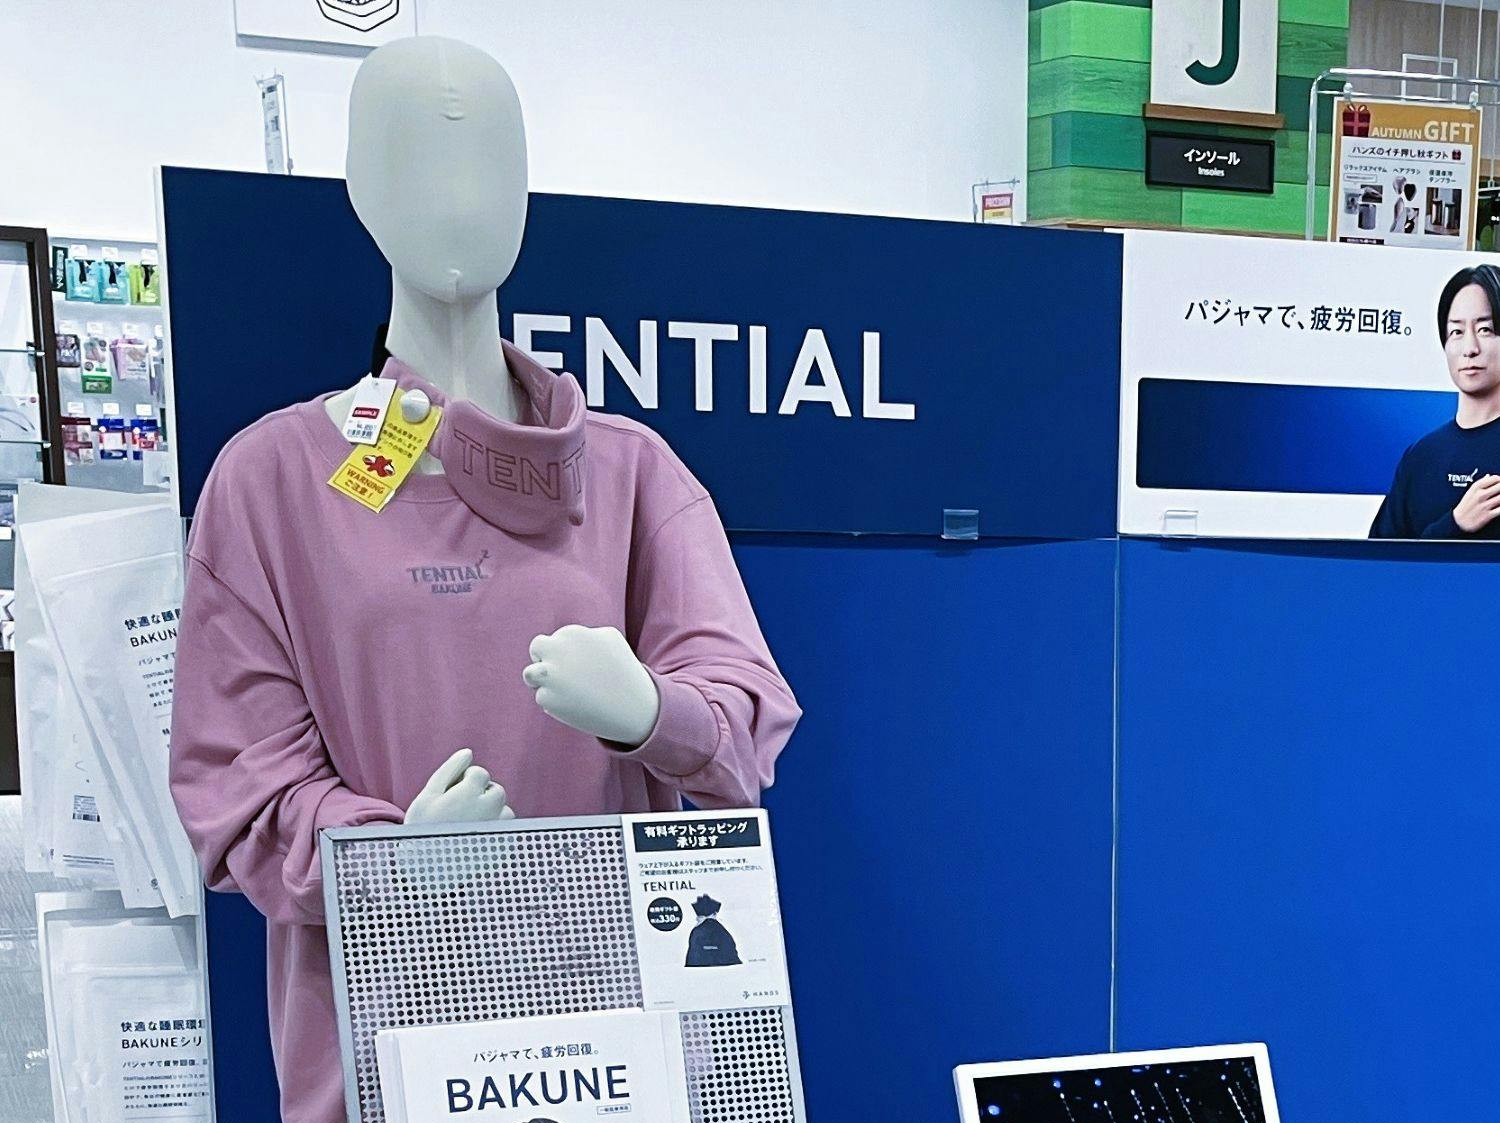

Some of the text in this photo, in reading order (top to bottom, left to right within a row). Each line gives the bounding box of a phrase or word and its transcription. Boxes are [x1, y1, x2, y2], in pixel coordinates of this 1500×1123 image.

[1185, 0, 1240, 86] J
[1371, 120, 1475, 143] AUTUMN GIFT
[1184, 148, 1240, 165] インソール
[1185, 299, 1412, 336] パジャマで、疲労回復。
[513, 313, 915, 420] ENTIAL
[346, 468, 385, 494] WARNING
[407, 564, 489, 584] TENTIAL
[130, 628, 178, 648] BAKUN
[644, 821, 748, 838] 有料ギフトラッピング
[677, 835, 719, 849] 承ります
[643, 880, 696, 892] TENTIAL
[474, 1043, 599, 1063] パジャマで、疲労回復。
[446, 1065, 630, 1113] BAKUNE
